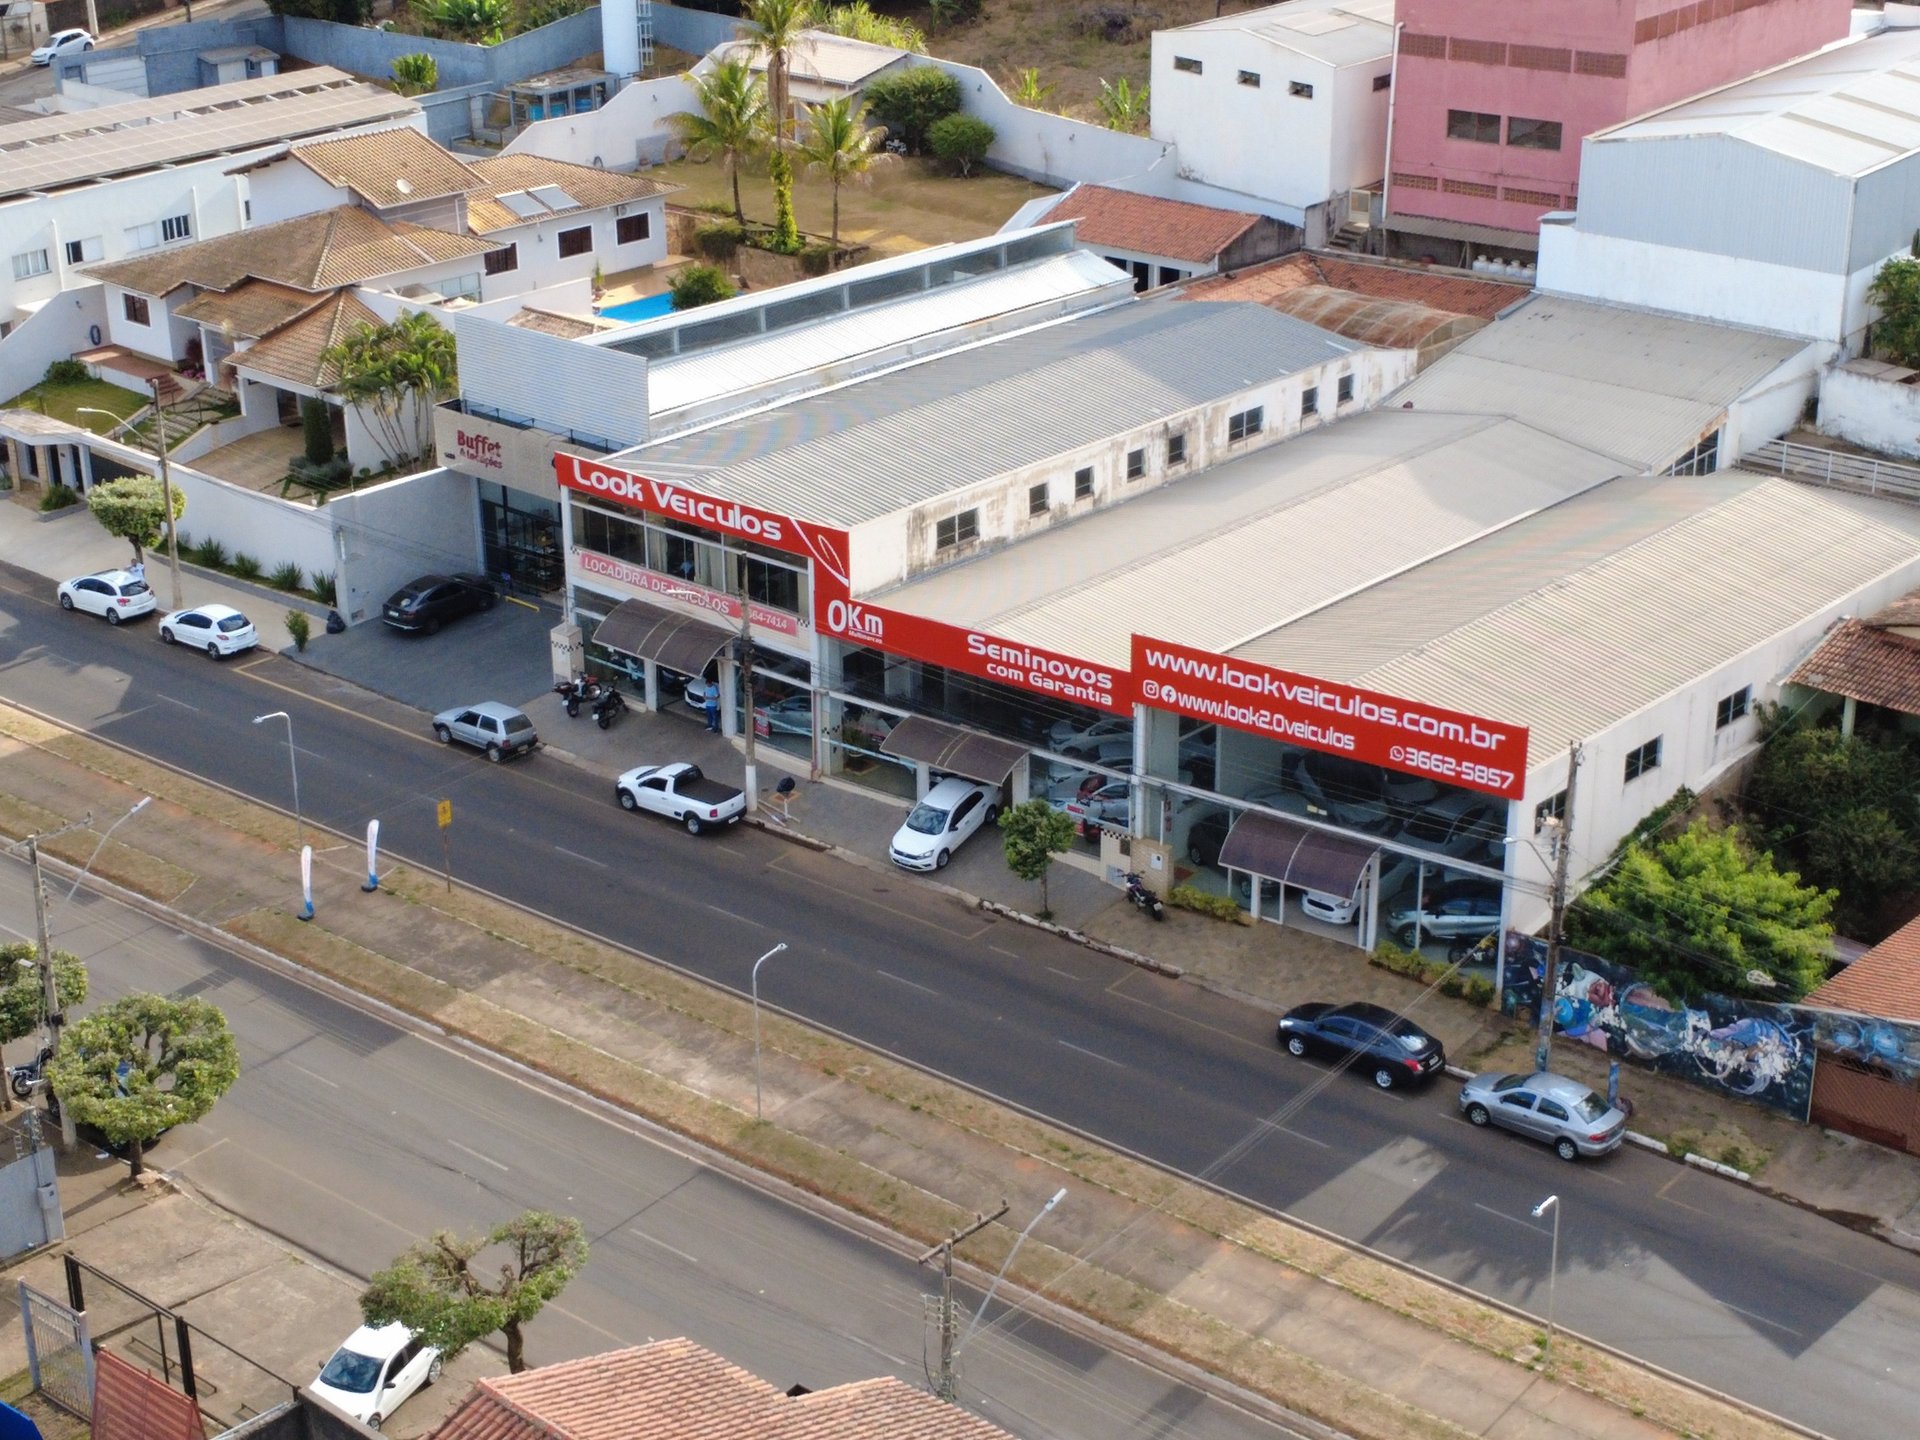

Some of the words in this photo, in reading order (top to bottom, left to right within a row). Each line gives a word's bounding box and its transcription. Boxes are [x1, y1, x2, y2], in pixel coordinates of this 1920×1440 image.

[457, 430, 501, 455] Buffet
[573, 459, 643, 501] Look
[584, 558, 648, 588] LOCADORA
[651, 580, 669, 595] DE
[967, 634, 1113, 689] Seminovos
[986, 663, 1024, 682] com
[1028, 672, 1113, 706] Garantia
[1145, 649, 1506, 750] www.lookveiculos.com.br
[1178, 693, 1355, 750] www.look2.0veiculos
[1404, 746, 1515, 790] 3662-5857
